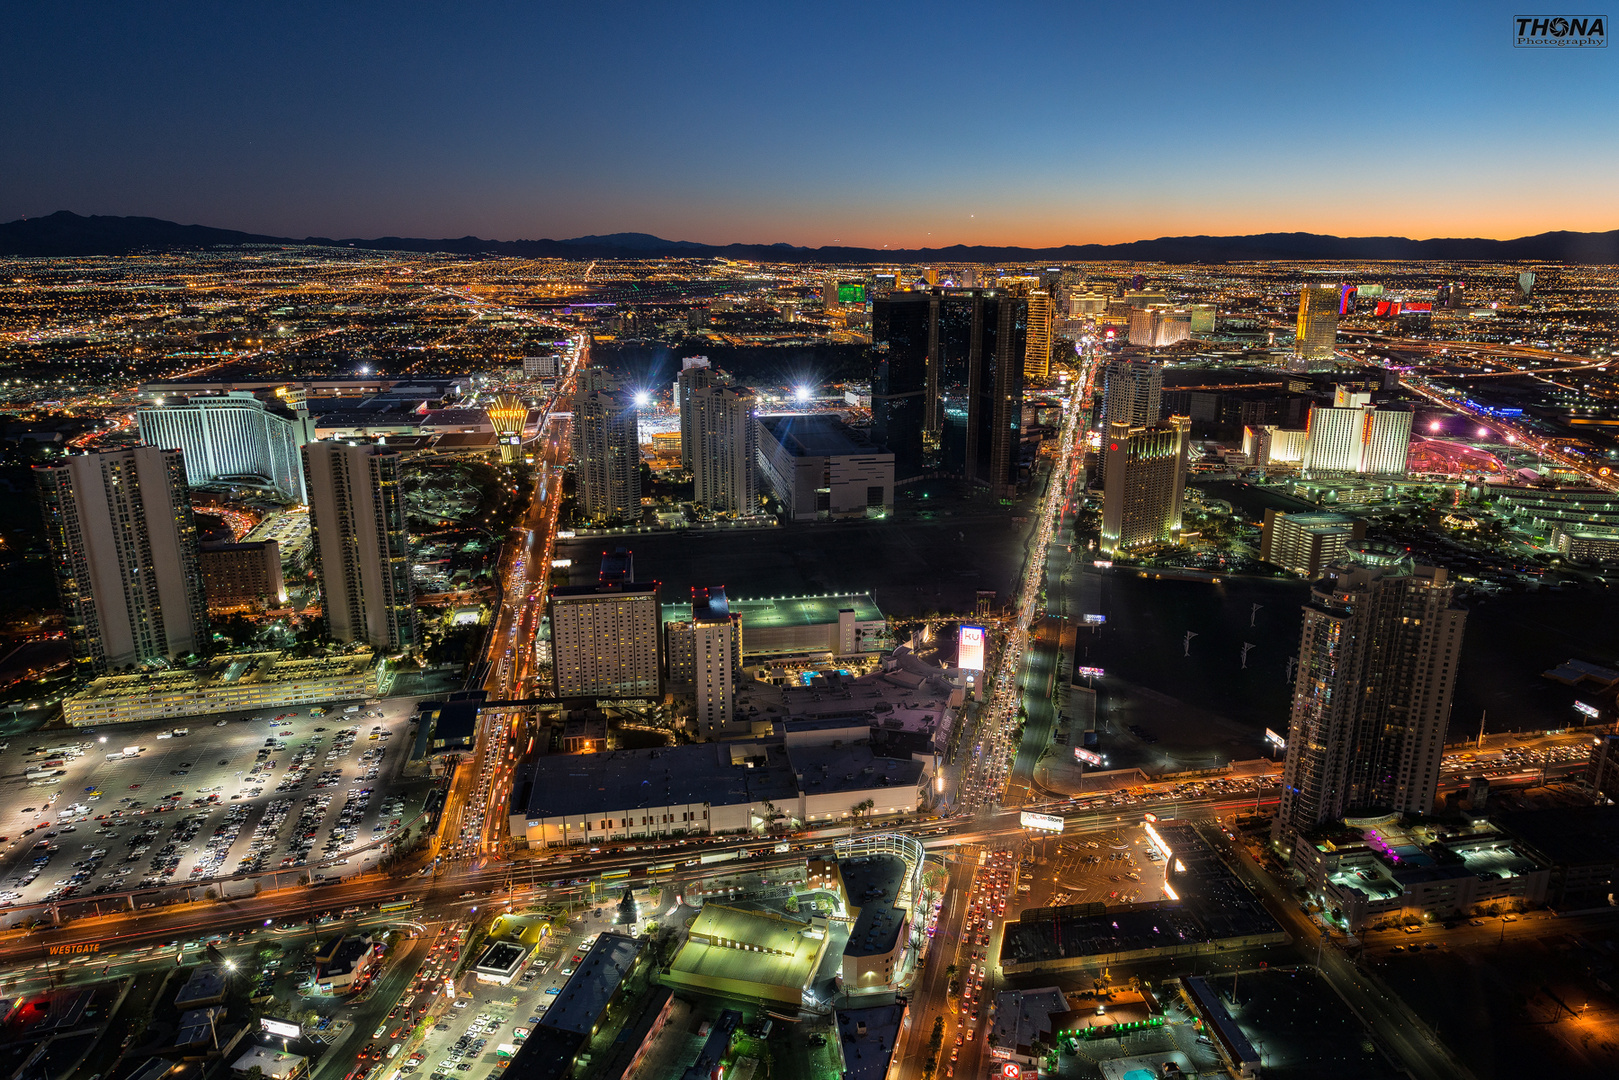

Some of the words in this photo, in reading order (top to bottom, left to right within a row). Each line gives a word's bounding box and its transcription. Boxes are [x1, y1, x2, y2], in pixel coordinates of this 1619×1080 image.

[490, 409, 525, 417] WESTGATE
[50, 944, 99, 955] WESTGATE
[1007, 1067, 1017, 1076] K
